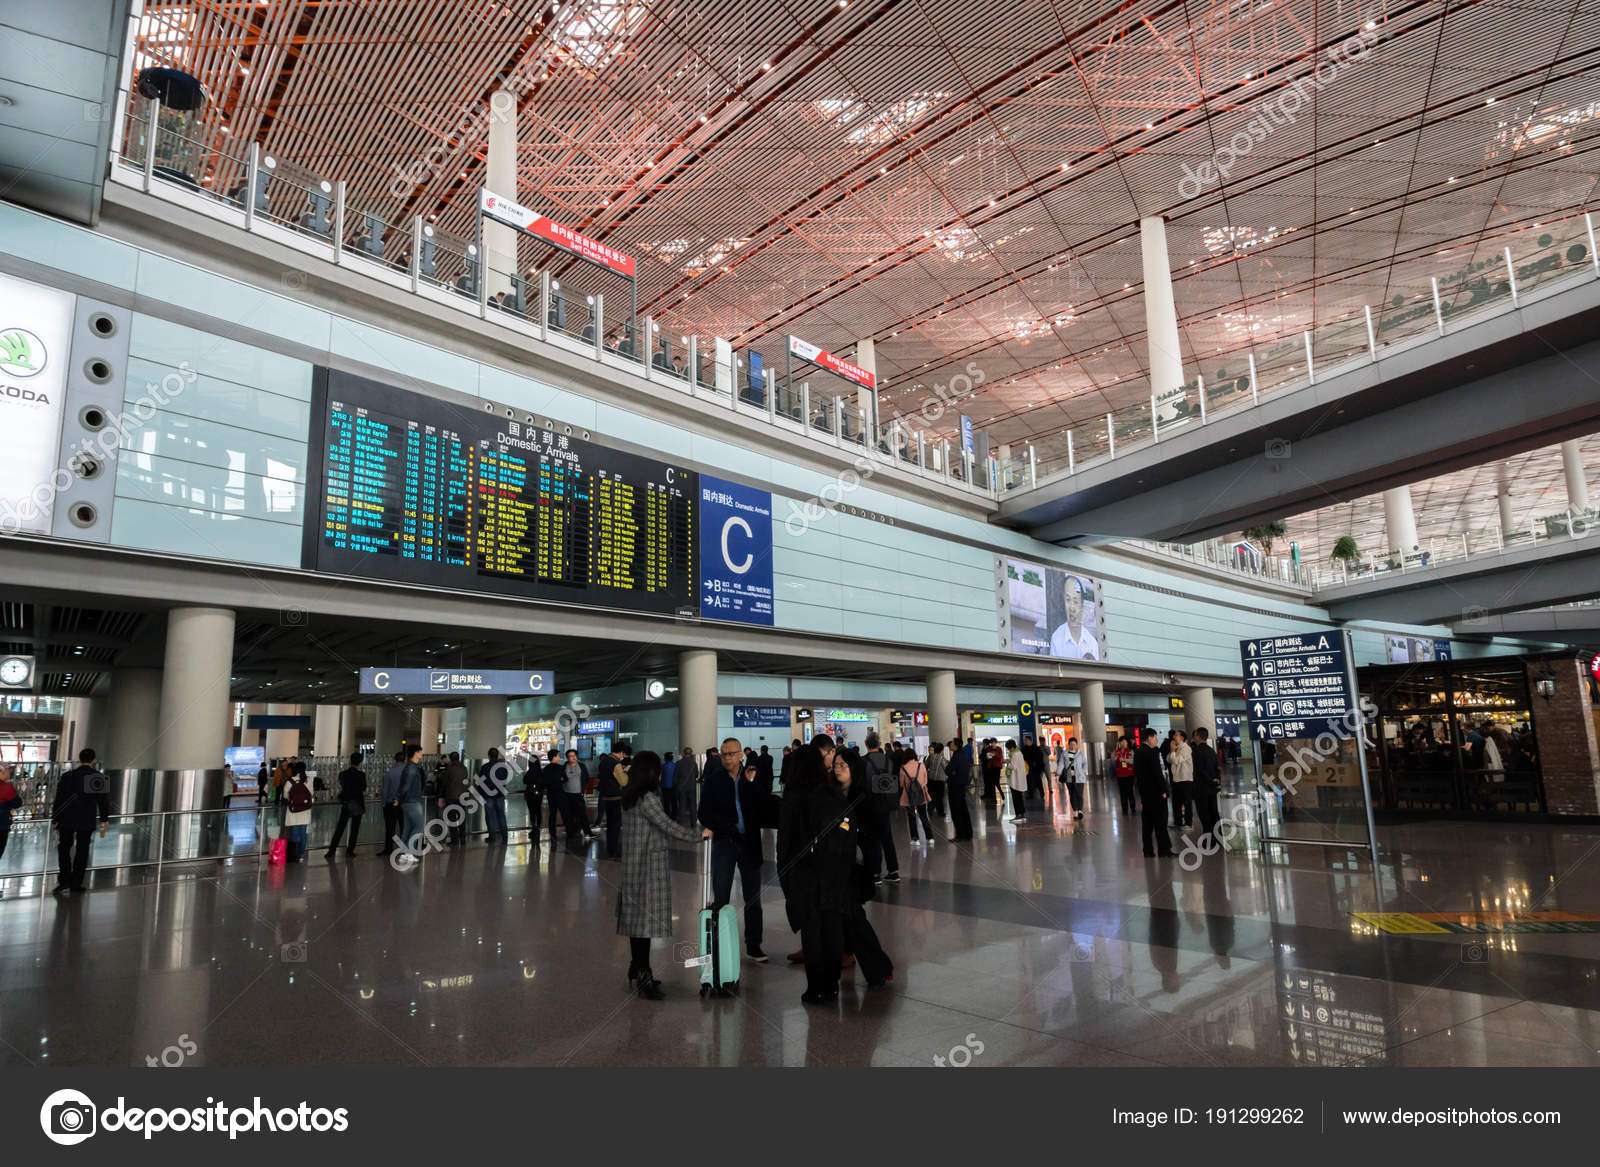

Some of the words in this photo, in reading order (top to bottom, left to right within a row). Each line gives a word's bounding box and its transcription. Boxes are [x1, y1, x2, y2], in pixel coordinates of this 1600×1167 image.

[570, 241, 583, 252] Self
[582, 247, 609, 264] Check-in
[509, 421, 569, 450] 国内到港
[497, 431, 542, 453] Domestic
[545, 446, 579, 463] Arrivals
[666, 467, 675, 484] C
[702, 488, 734, 507] 国内到达
[735, 501, 755, 513] Domestic
[754, 505, 770, 516] Arrivals
[721, 516, 754, 574] C
[714, 579, 722, 592] B
[714, 595, 722, 608] A
[1275, 636, 1303, 648] 国内到达
[1318, 635, 1330, 650] A
[374, 672, 390, 689] C
[451, 674, 482, 684] 国内到达
[529, 674, 543, 691] C
[1020, 702, 1032, 716] C
[1284, 721, 1305, 731] 出租车
